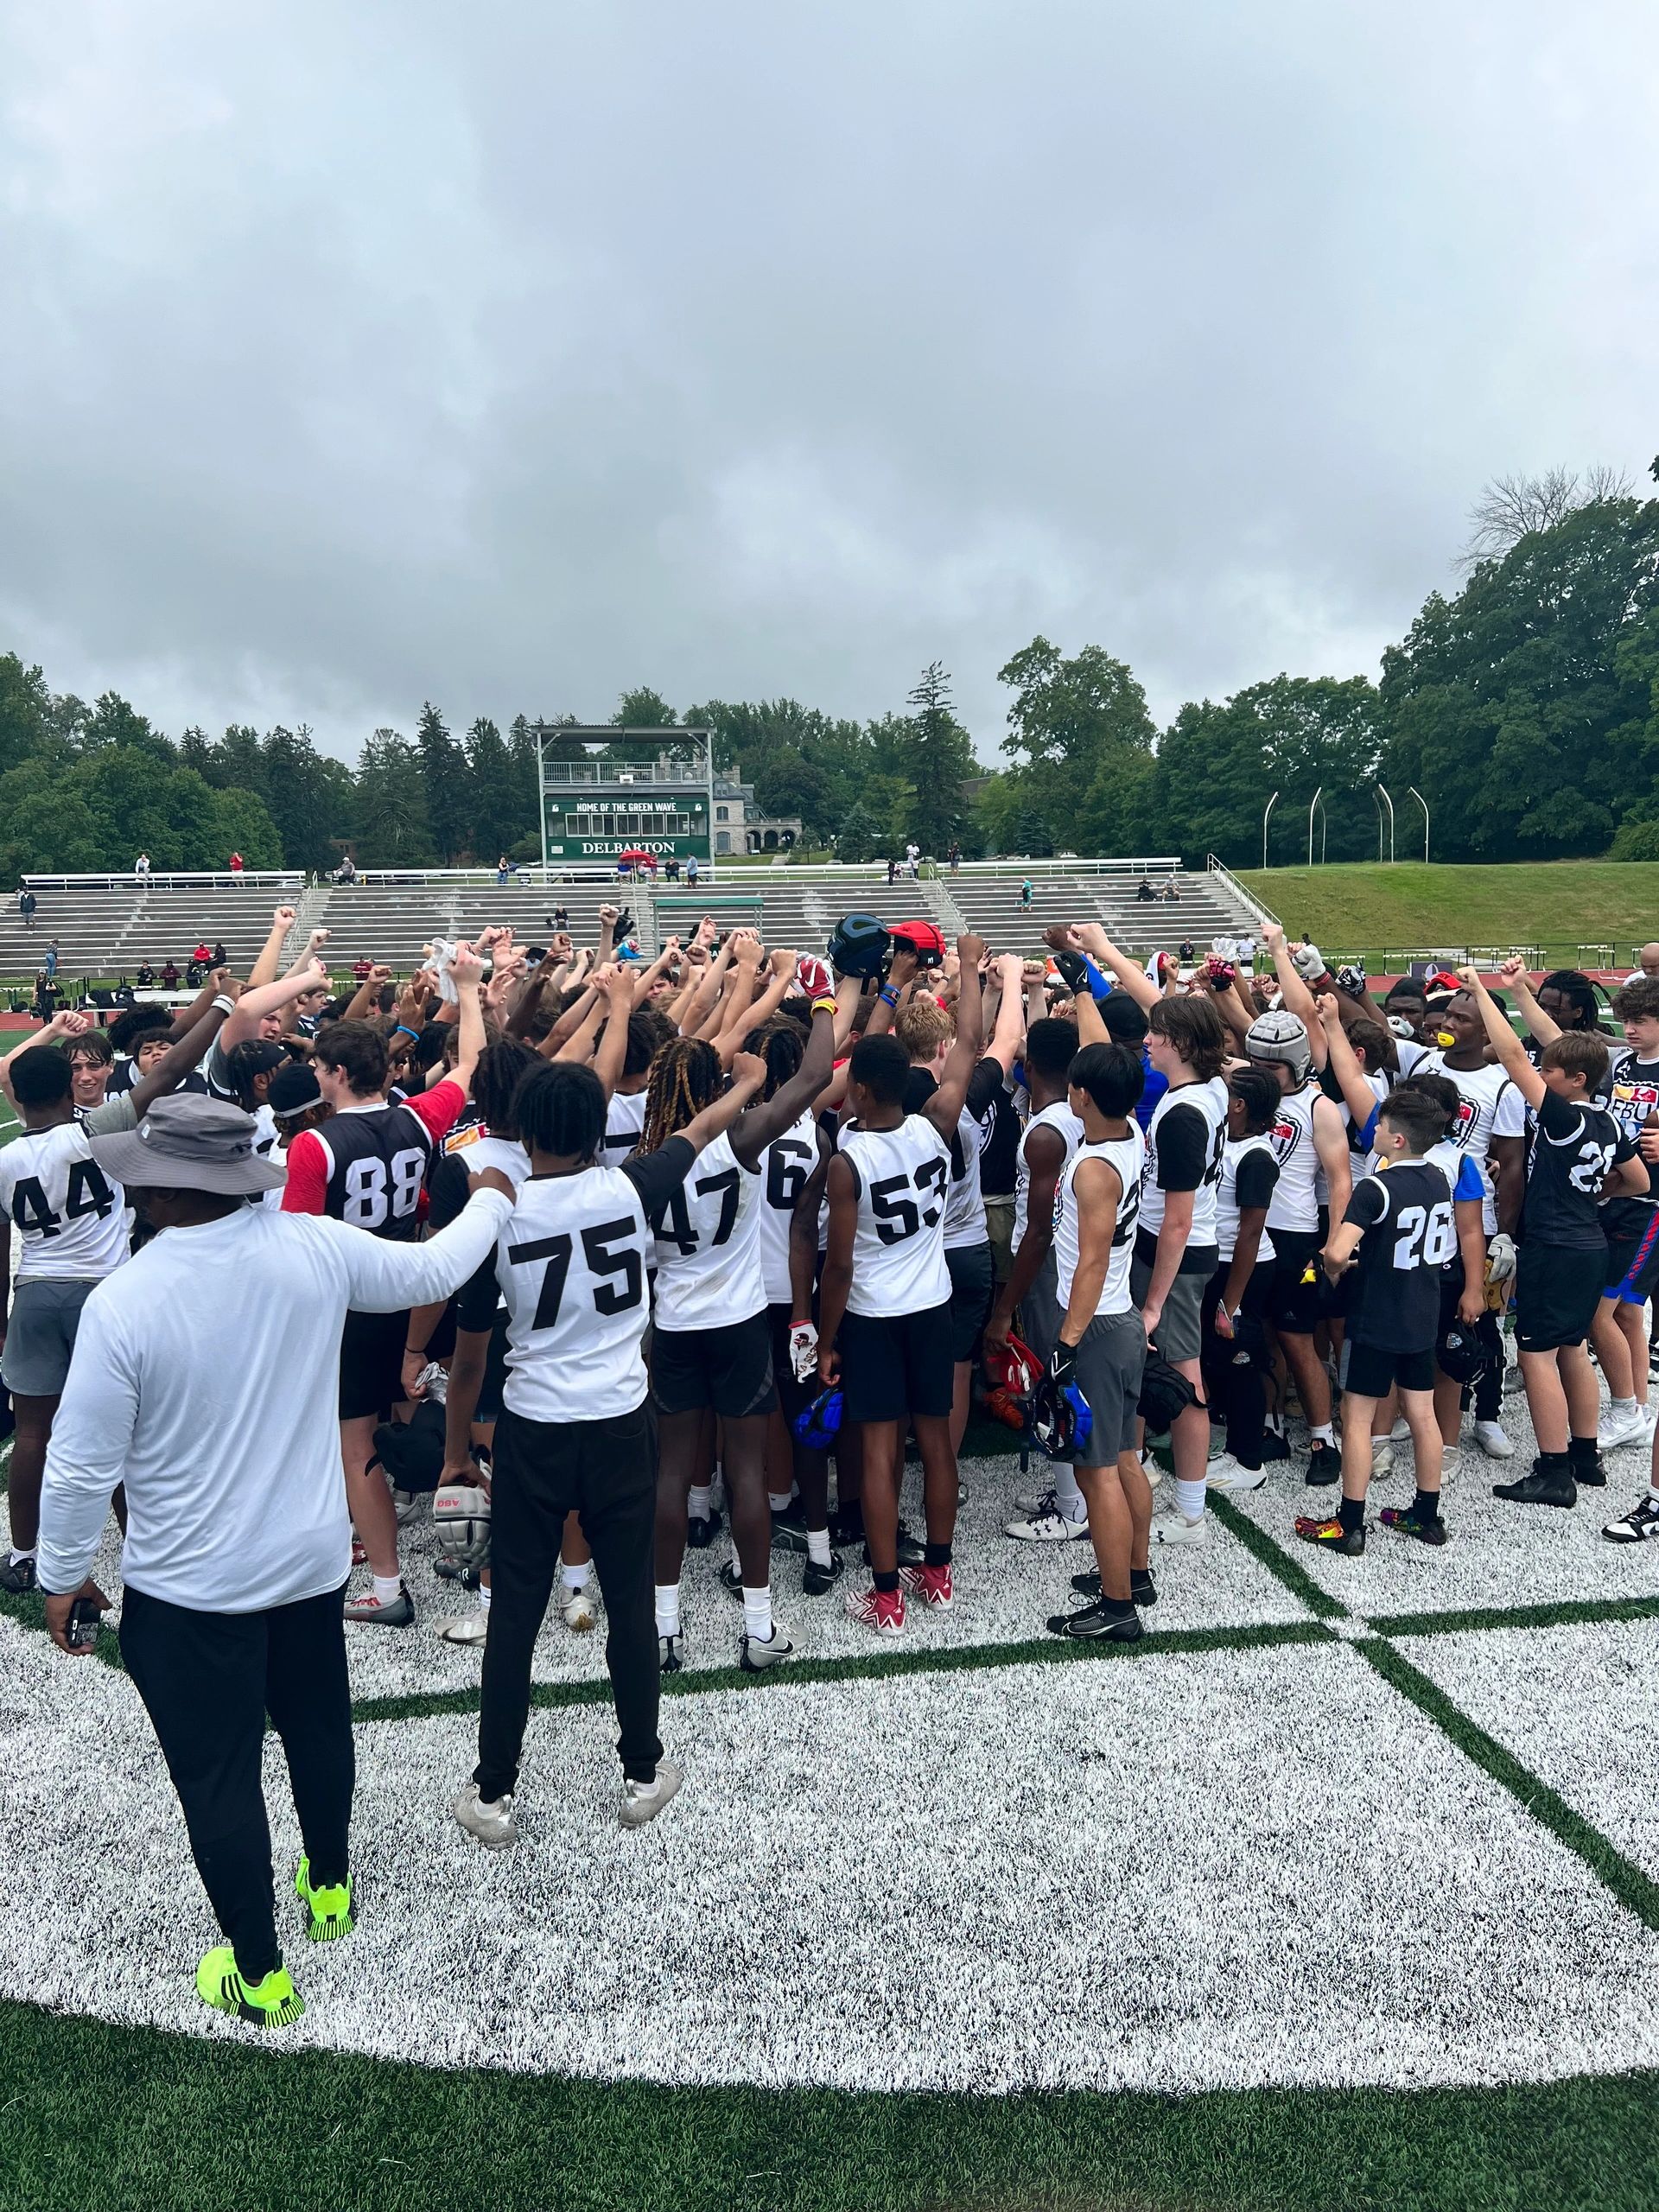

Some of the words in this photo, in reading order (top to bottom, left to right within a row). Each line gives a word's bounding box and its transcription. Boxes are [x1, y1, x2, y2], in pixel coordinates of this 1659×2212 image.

[577, 803, 599, 811] HOME
[601, 803, 610, 811] OF
[612, 803, 626, 811] THE
[628, 803, 653, 811] GREEN
[655, 802, 677, 811] WAVE
[582, 842, 676, 854] DELBARTON
[1612, 1098, 1652, 1122] FBU
[12, 1157, 116, 1238] 44
[343, 1146, 426, 1229] 88
[651, 1166, 741, 1256] 47
[869, 1155, 948, 1246] 53
[507, 1215, 643, 1331] 75
[1393, 1201, 1452, 1270] 26
